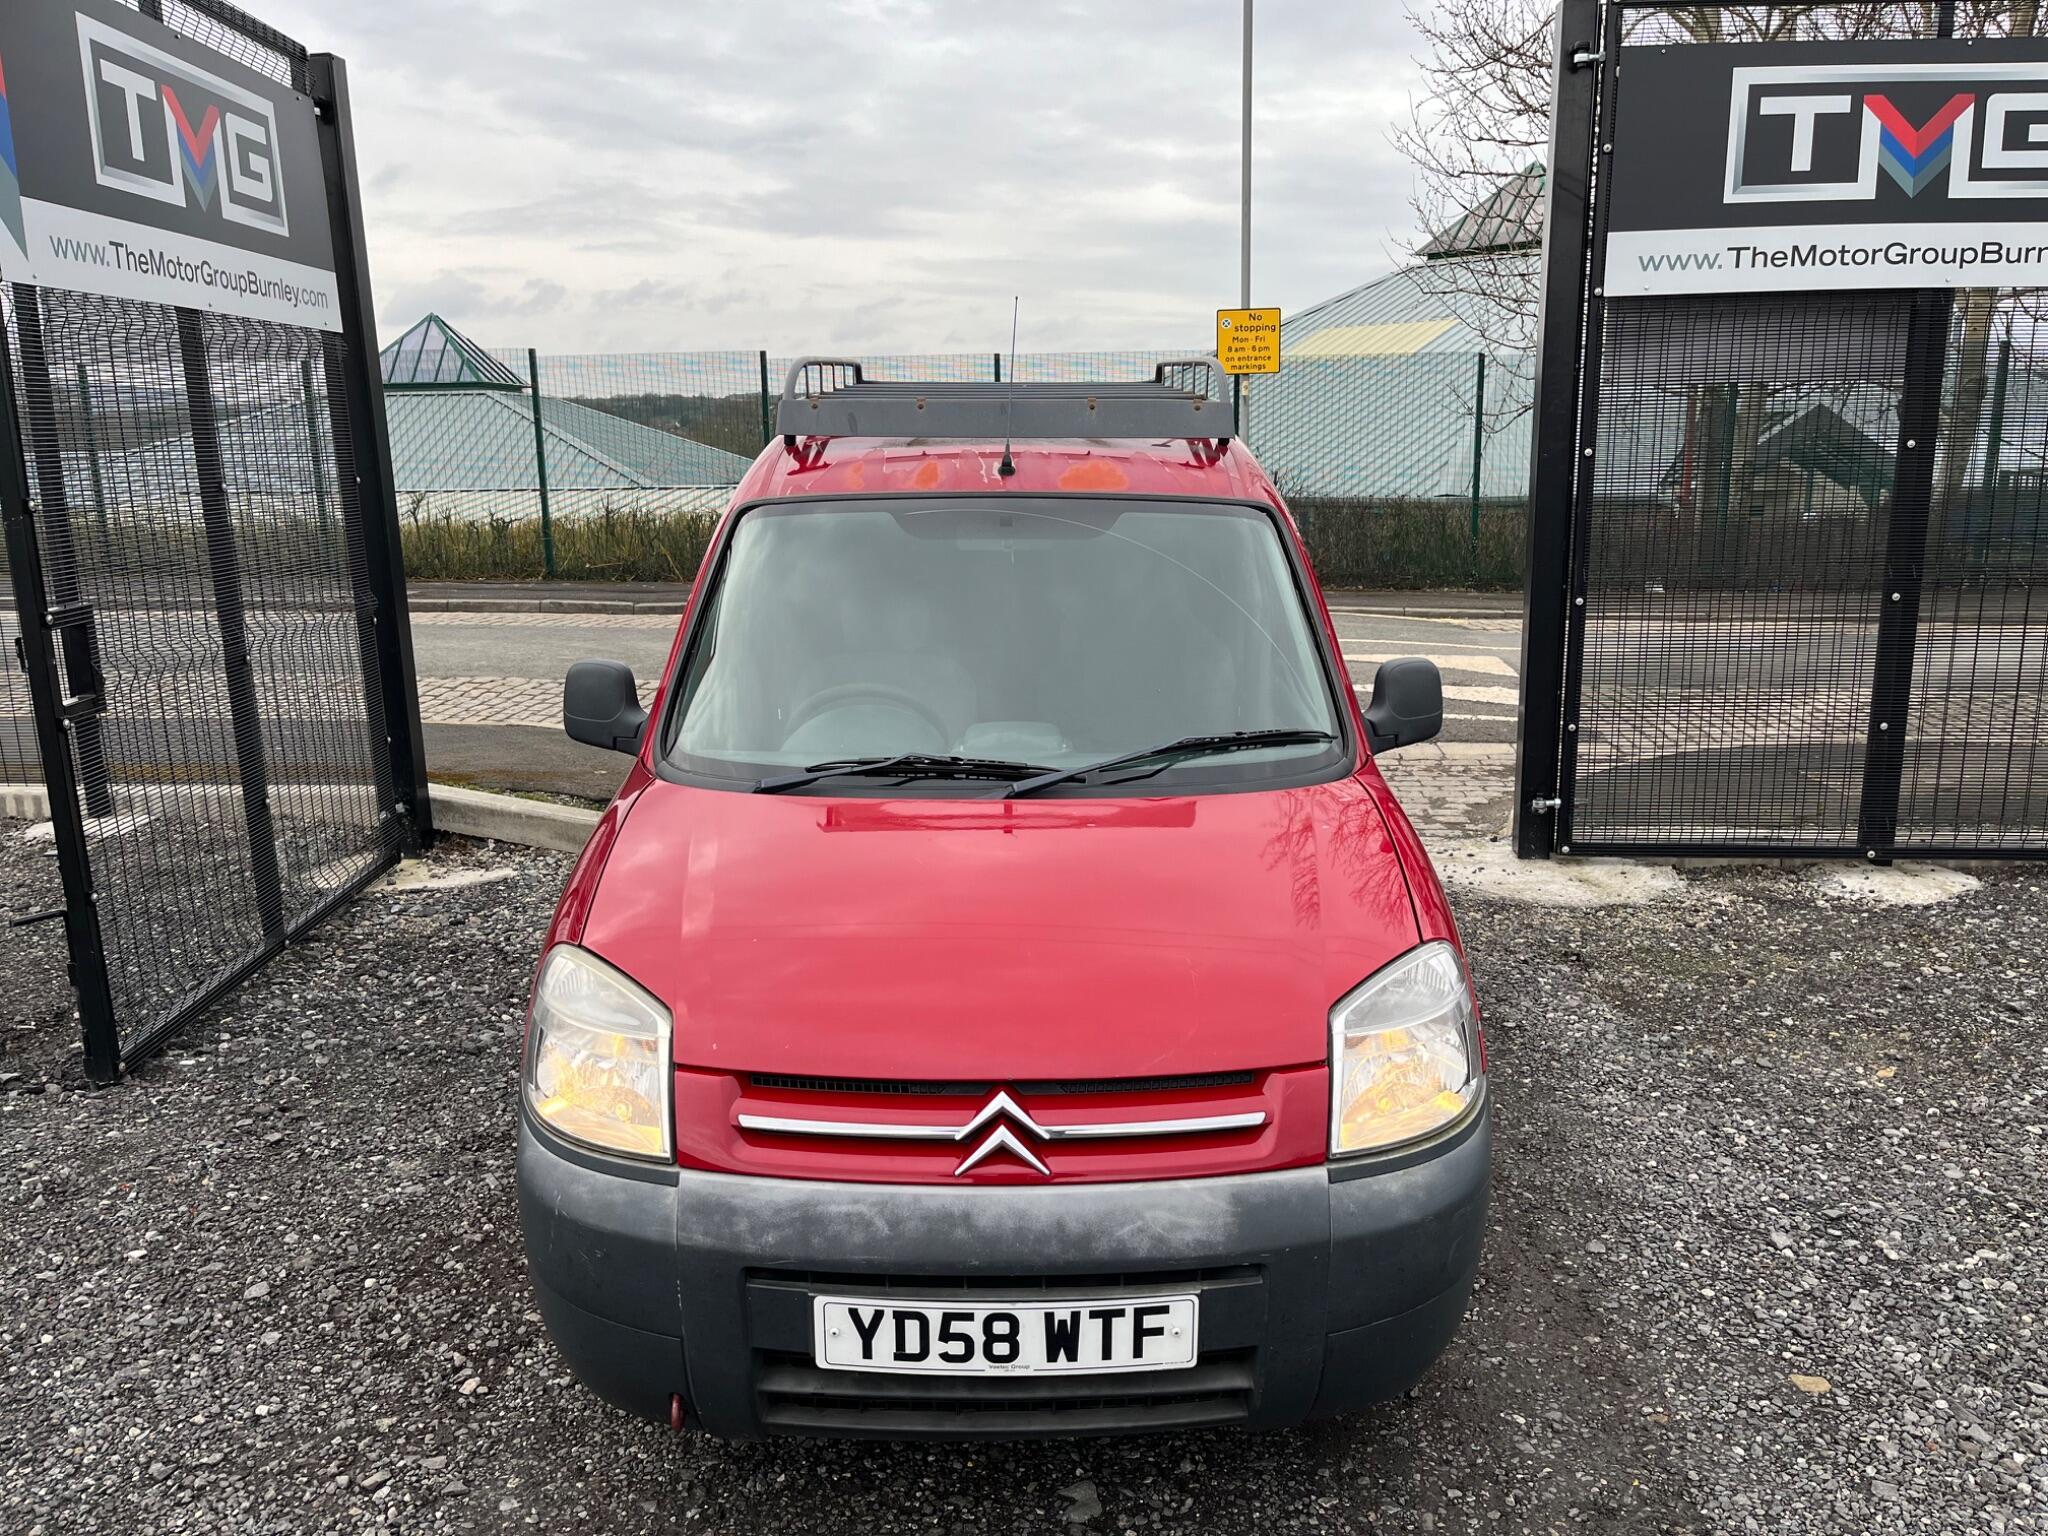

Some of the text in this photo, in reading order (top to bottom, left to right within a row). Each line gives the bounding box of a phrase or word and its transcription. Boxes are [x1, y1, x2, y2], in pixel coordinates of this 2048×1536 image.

[99, 58, 273, 212] TMG
[1759, 92, 2048, 199] TMG
[49, 234, 328, 309] www.TheMotorGroupBurnley.com
[1234, 324, 1276, 333] stopping
[1248, 313, 1263, 321] No
[1230, 363, 1266, 371] markings
[1237, 354, 1272, 362] entrance
[847, 1305, 1170, 1363] YD58 WTF
